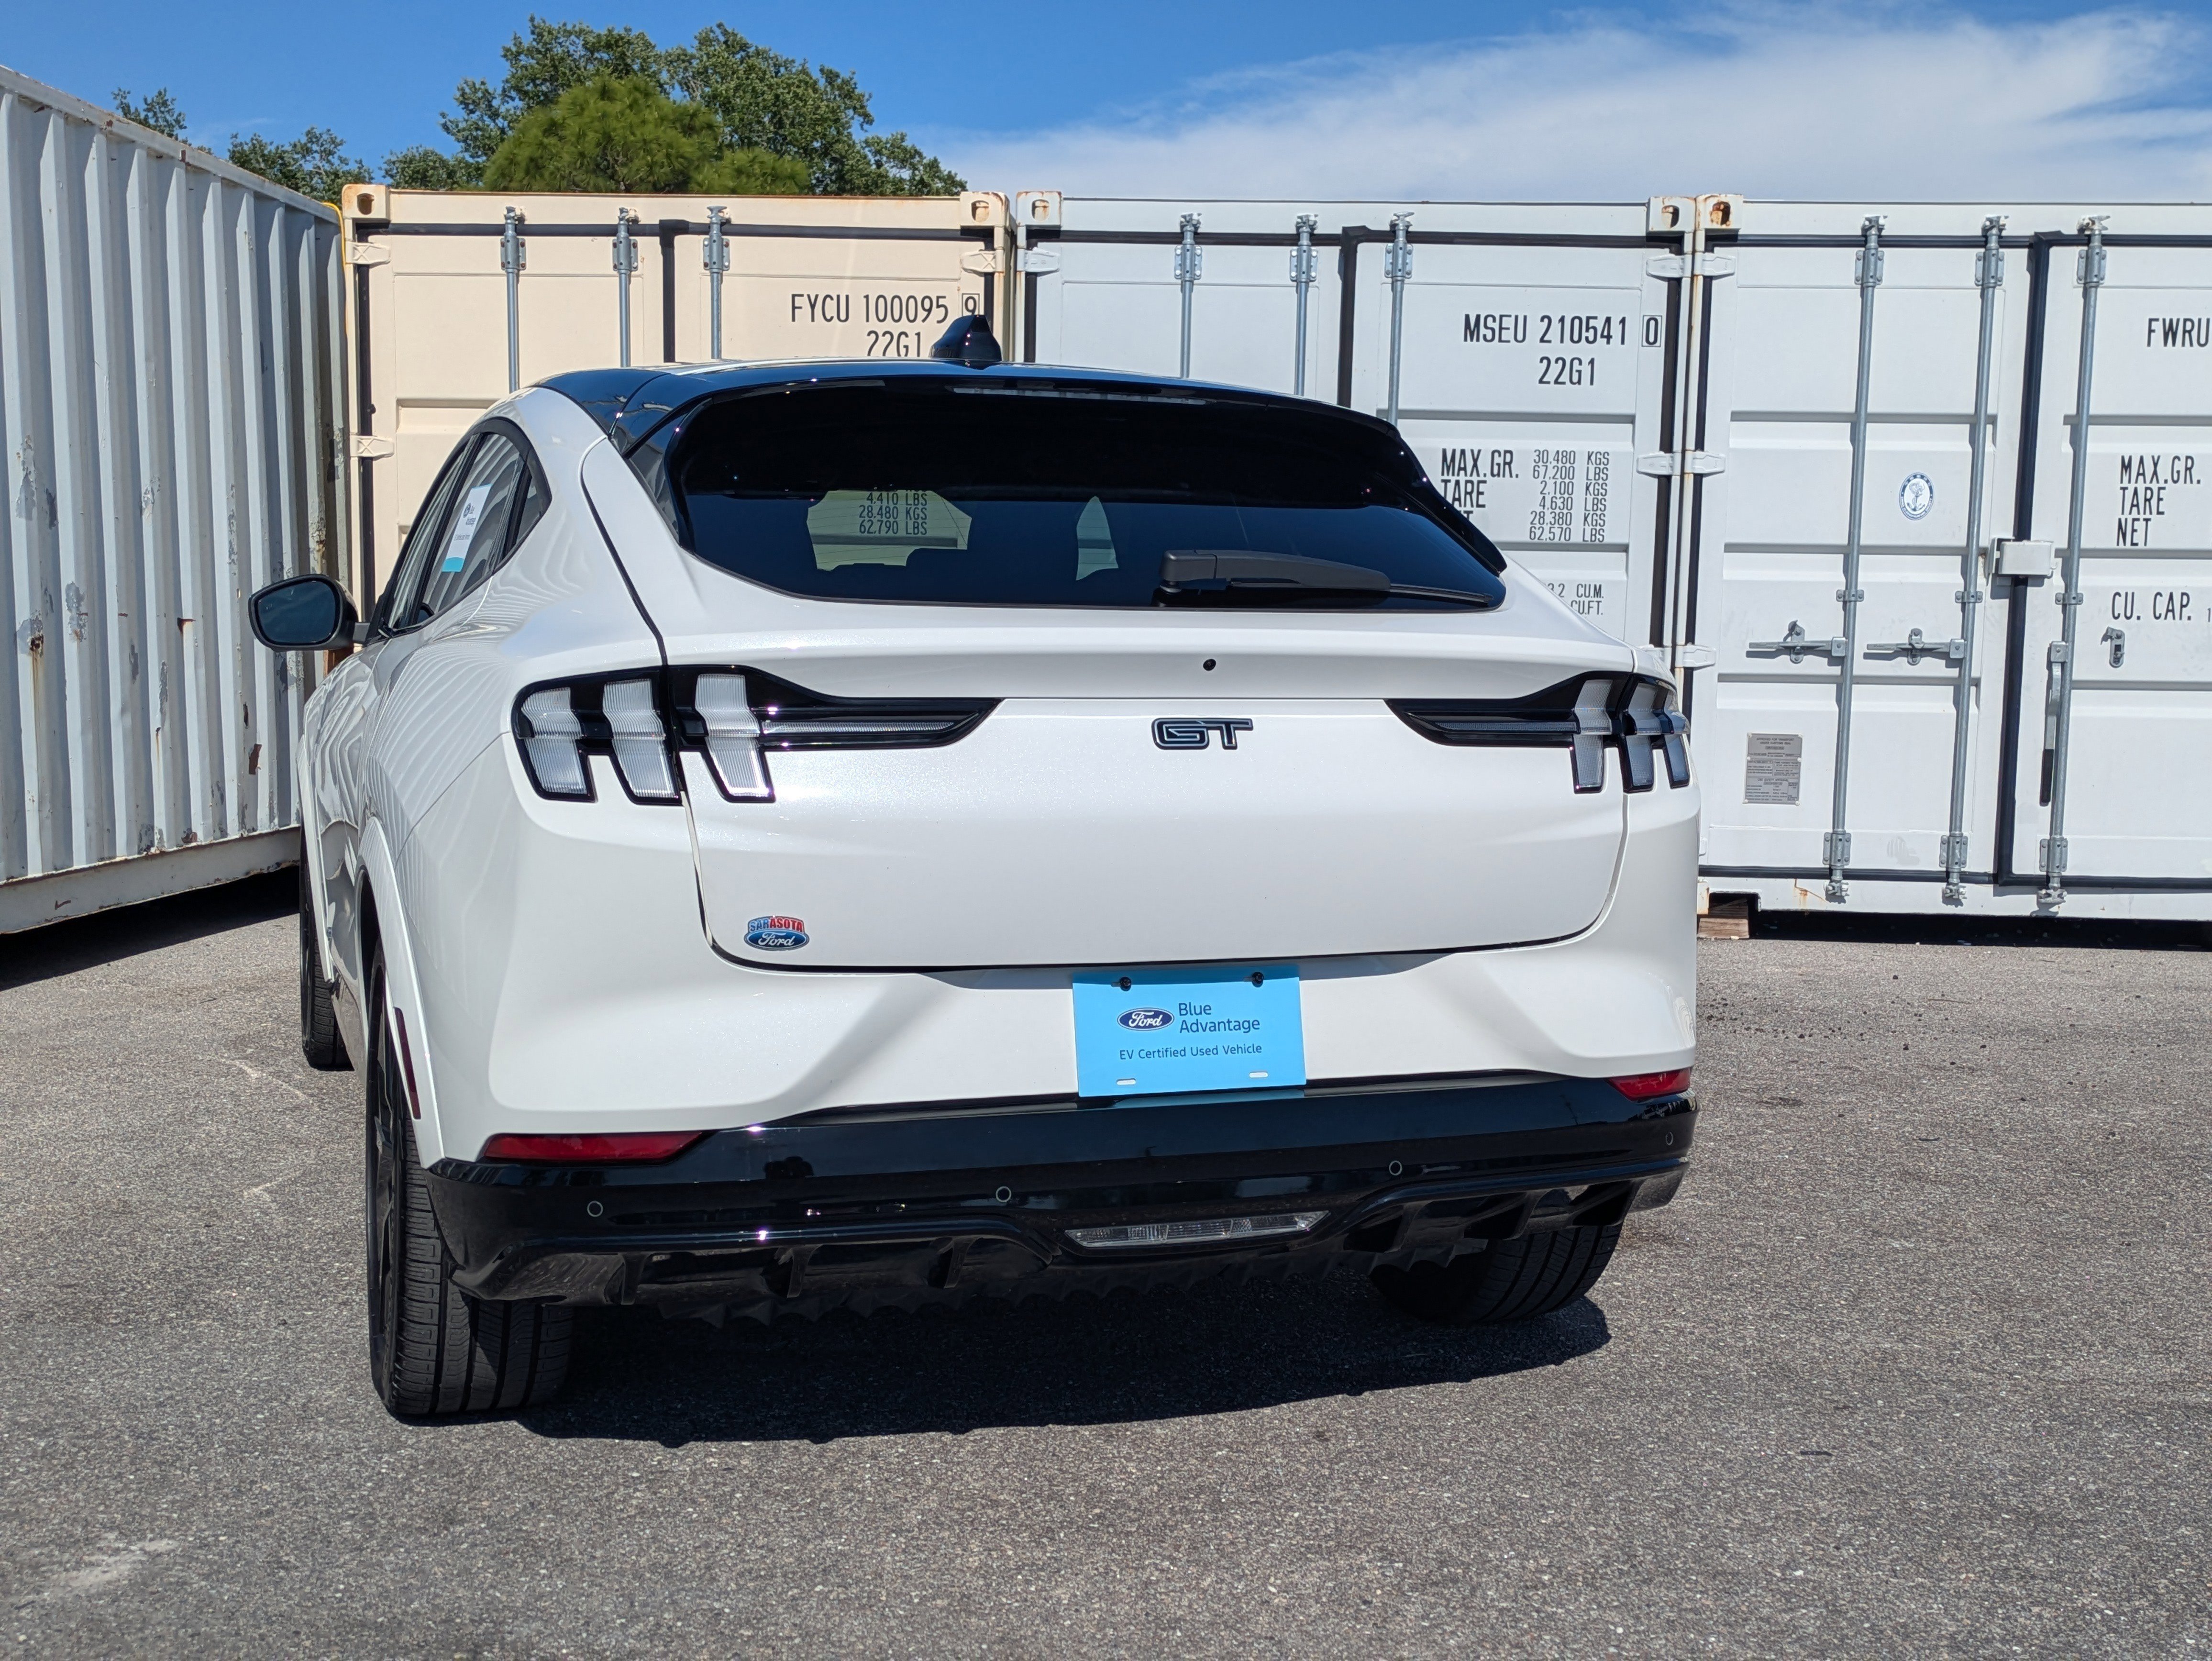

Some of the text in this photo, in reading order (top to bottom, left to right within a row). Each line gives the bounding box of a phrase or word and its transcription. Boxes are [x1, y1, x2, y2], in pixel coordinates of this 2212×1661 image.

[791, 293, 977, 324] FYCU 100095 9
[1463, 313, 1659, 345] MSEU 210541 0
[2146, 318, 2210, 347] FWRU
[866, 330, 921, 357] 22G1
[1538, 355, 1595, 386] 22G1
[1533, 449, 1576, 465] 30,480
[1587, 451, 1610, 466] KGS
[1532, 465, 1609, 481] 67,200 LBS
[905, 493, 928, 507] LBS
[1441, 479, 1608, 508] TARE 2,100 KGS
[2119, 486, 2167, 516] TARE
[1538, 496, 1607, 512] 4,630 LBS
[905, 507, 928, 520] KGS
[1530, 510, 1606, 528] 28,380 KGS
[905, 520, 928, 535] LBS
[1529, 526, 1605, 543] 62,570 LBS
[2116, 517, 2152, 547] NET
[2111, 591, 2141, 621] CU.
[2153, 591, 2192, 621] CAP.
[1151, 717, 1253, 750] GT
[750, 917, 803, 932] SARASOTA
[758, 932, 795, 946] Ford
[1178, 1002, 1212, 1017] Blue
[1128, 1011, 1163, 1028] Ford
[1179, 1018, 1261, 1034] Advantage
[1119, 1043, 1262, 1060] EV Certified Used Vehicle
